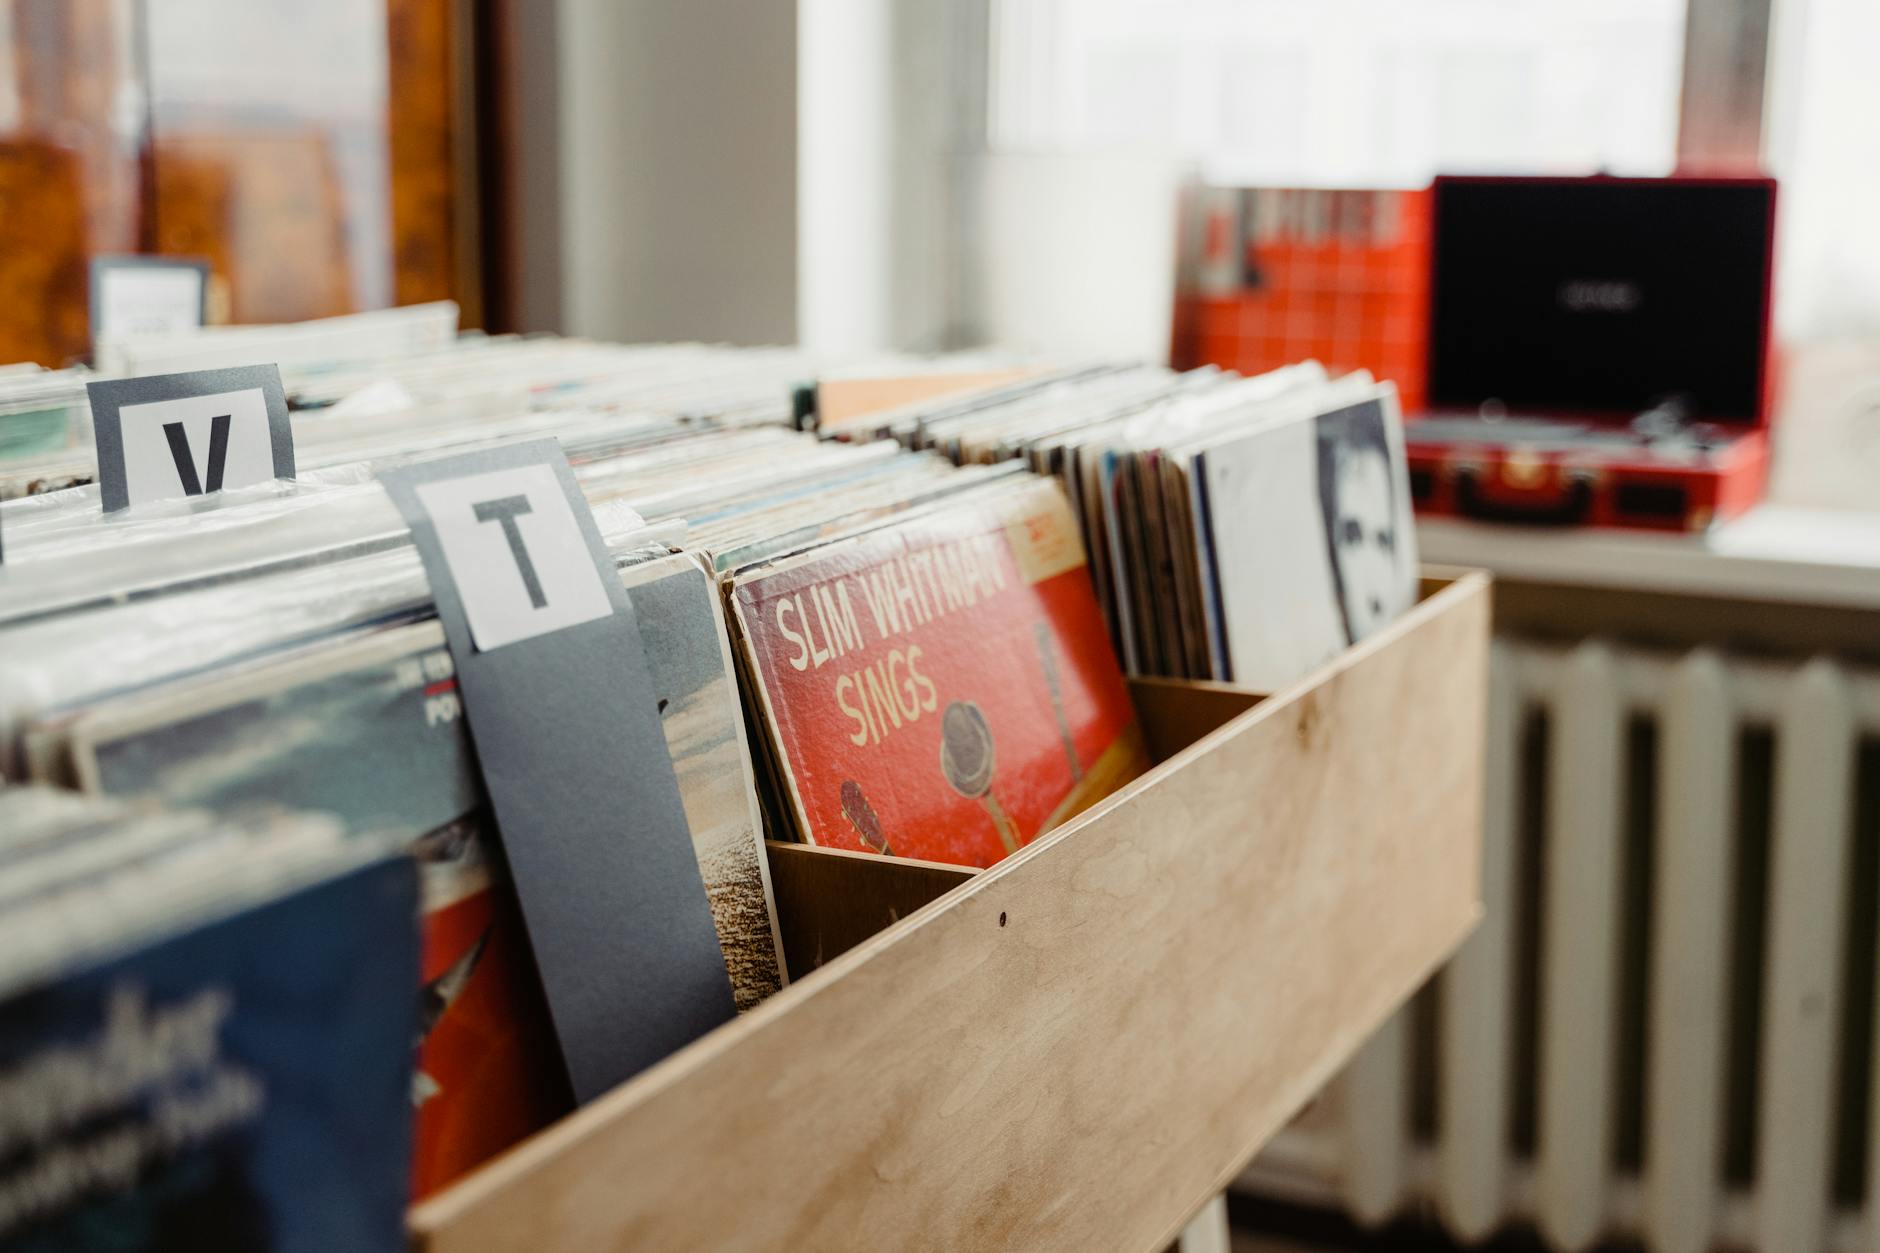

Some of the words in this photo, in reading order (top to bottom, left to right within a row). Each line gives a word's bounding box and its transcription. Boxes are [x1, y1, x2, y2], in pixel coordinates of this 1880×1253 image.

[162, 414, 231, 496] V
[471, 494, 548, 610] T
[776, 579, 865, 671] SLIM
[857, 534, 1006, 639] WHITMAN
[836, 645, 938, 746] SINGS
